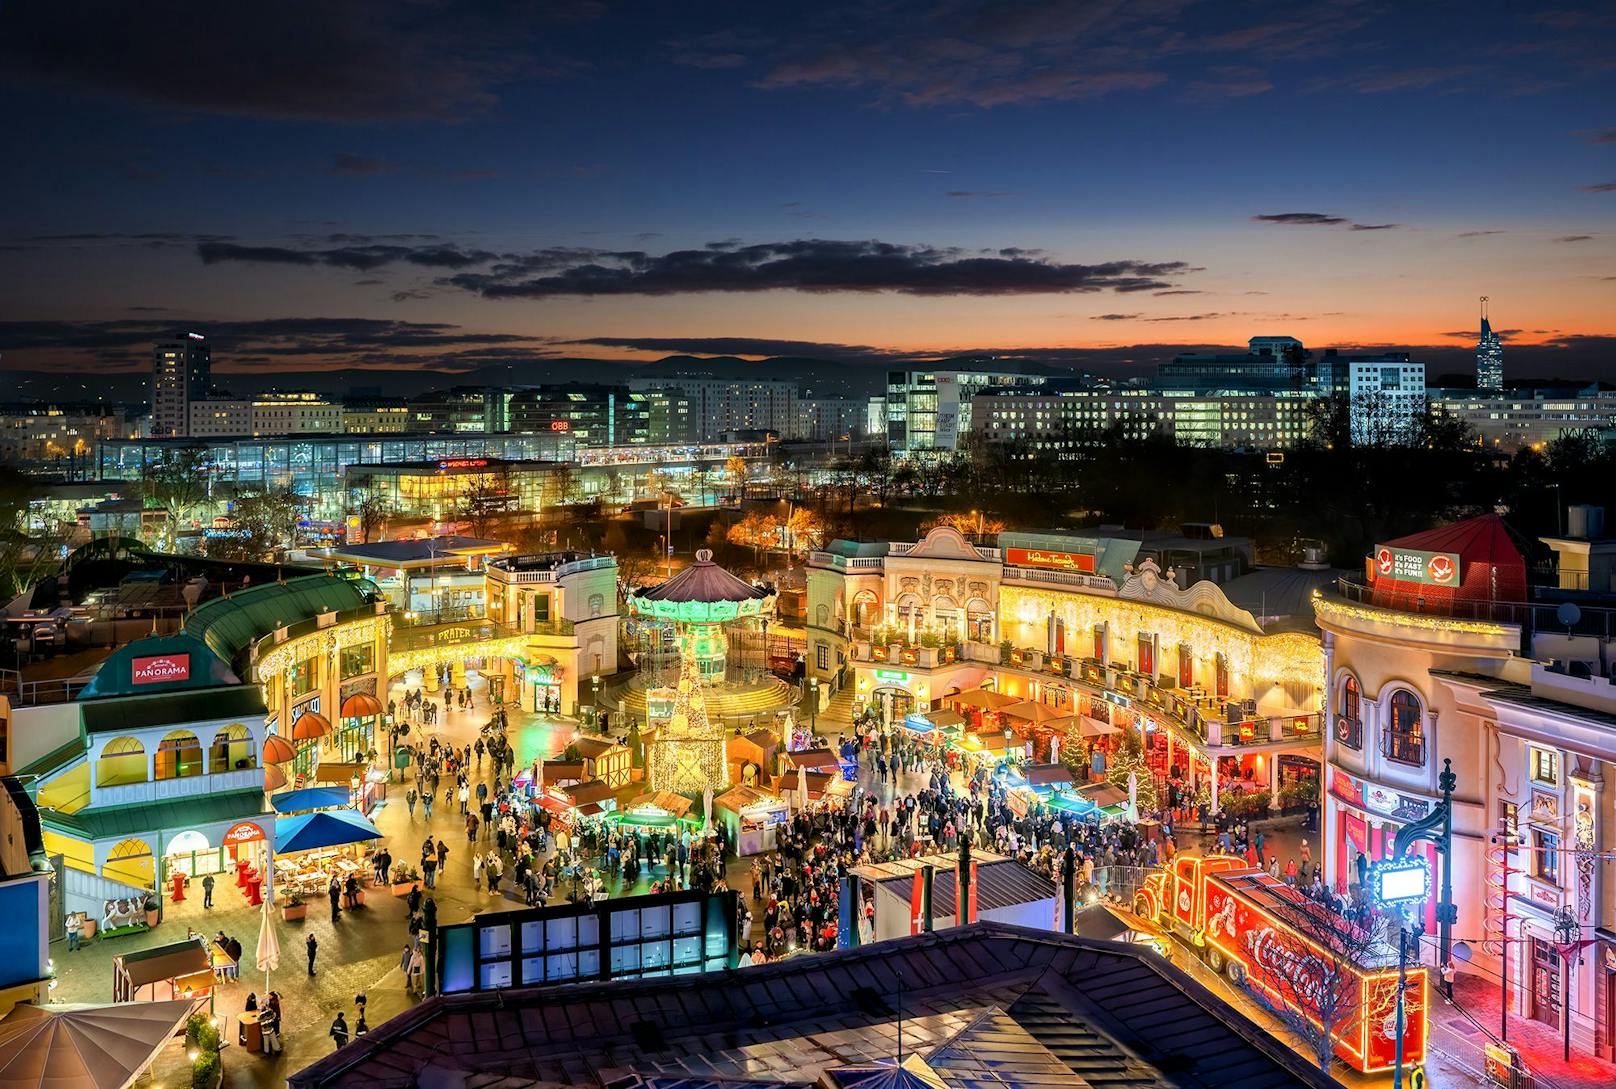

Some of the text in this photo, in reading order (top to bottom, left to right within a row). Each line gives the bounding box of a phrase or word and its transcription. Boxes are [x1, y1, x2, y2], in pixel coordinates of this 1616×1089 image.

[1403, 555, 1422, 563] FOOD
[1404, 562, 1422, 570] FAST
[438, 627, 470, 640] PRATER
[135, 667, 186, 678] PANORAMA
[227, 829, 260, 839] PANORAMA
